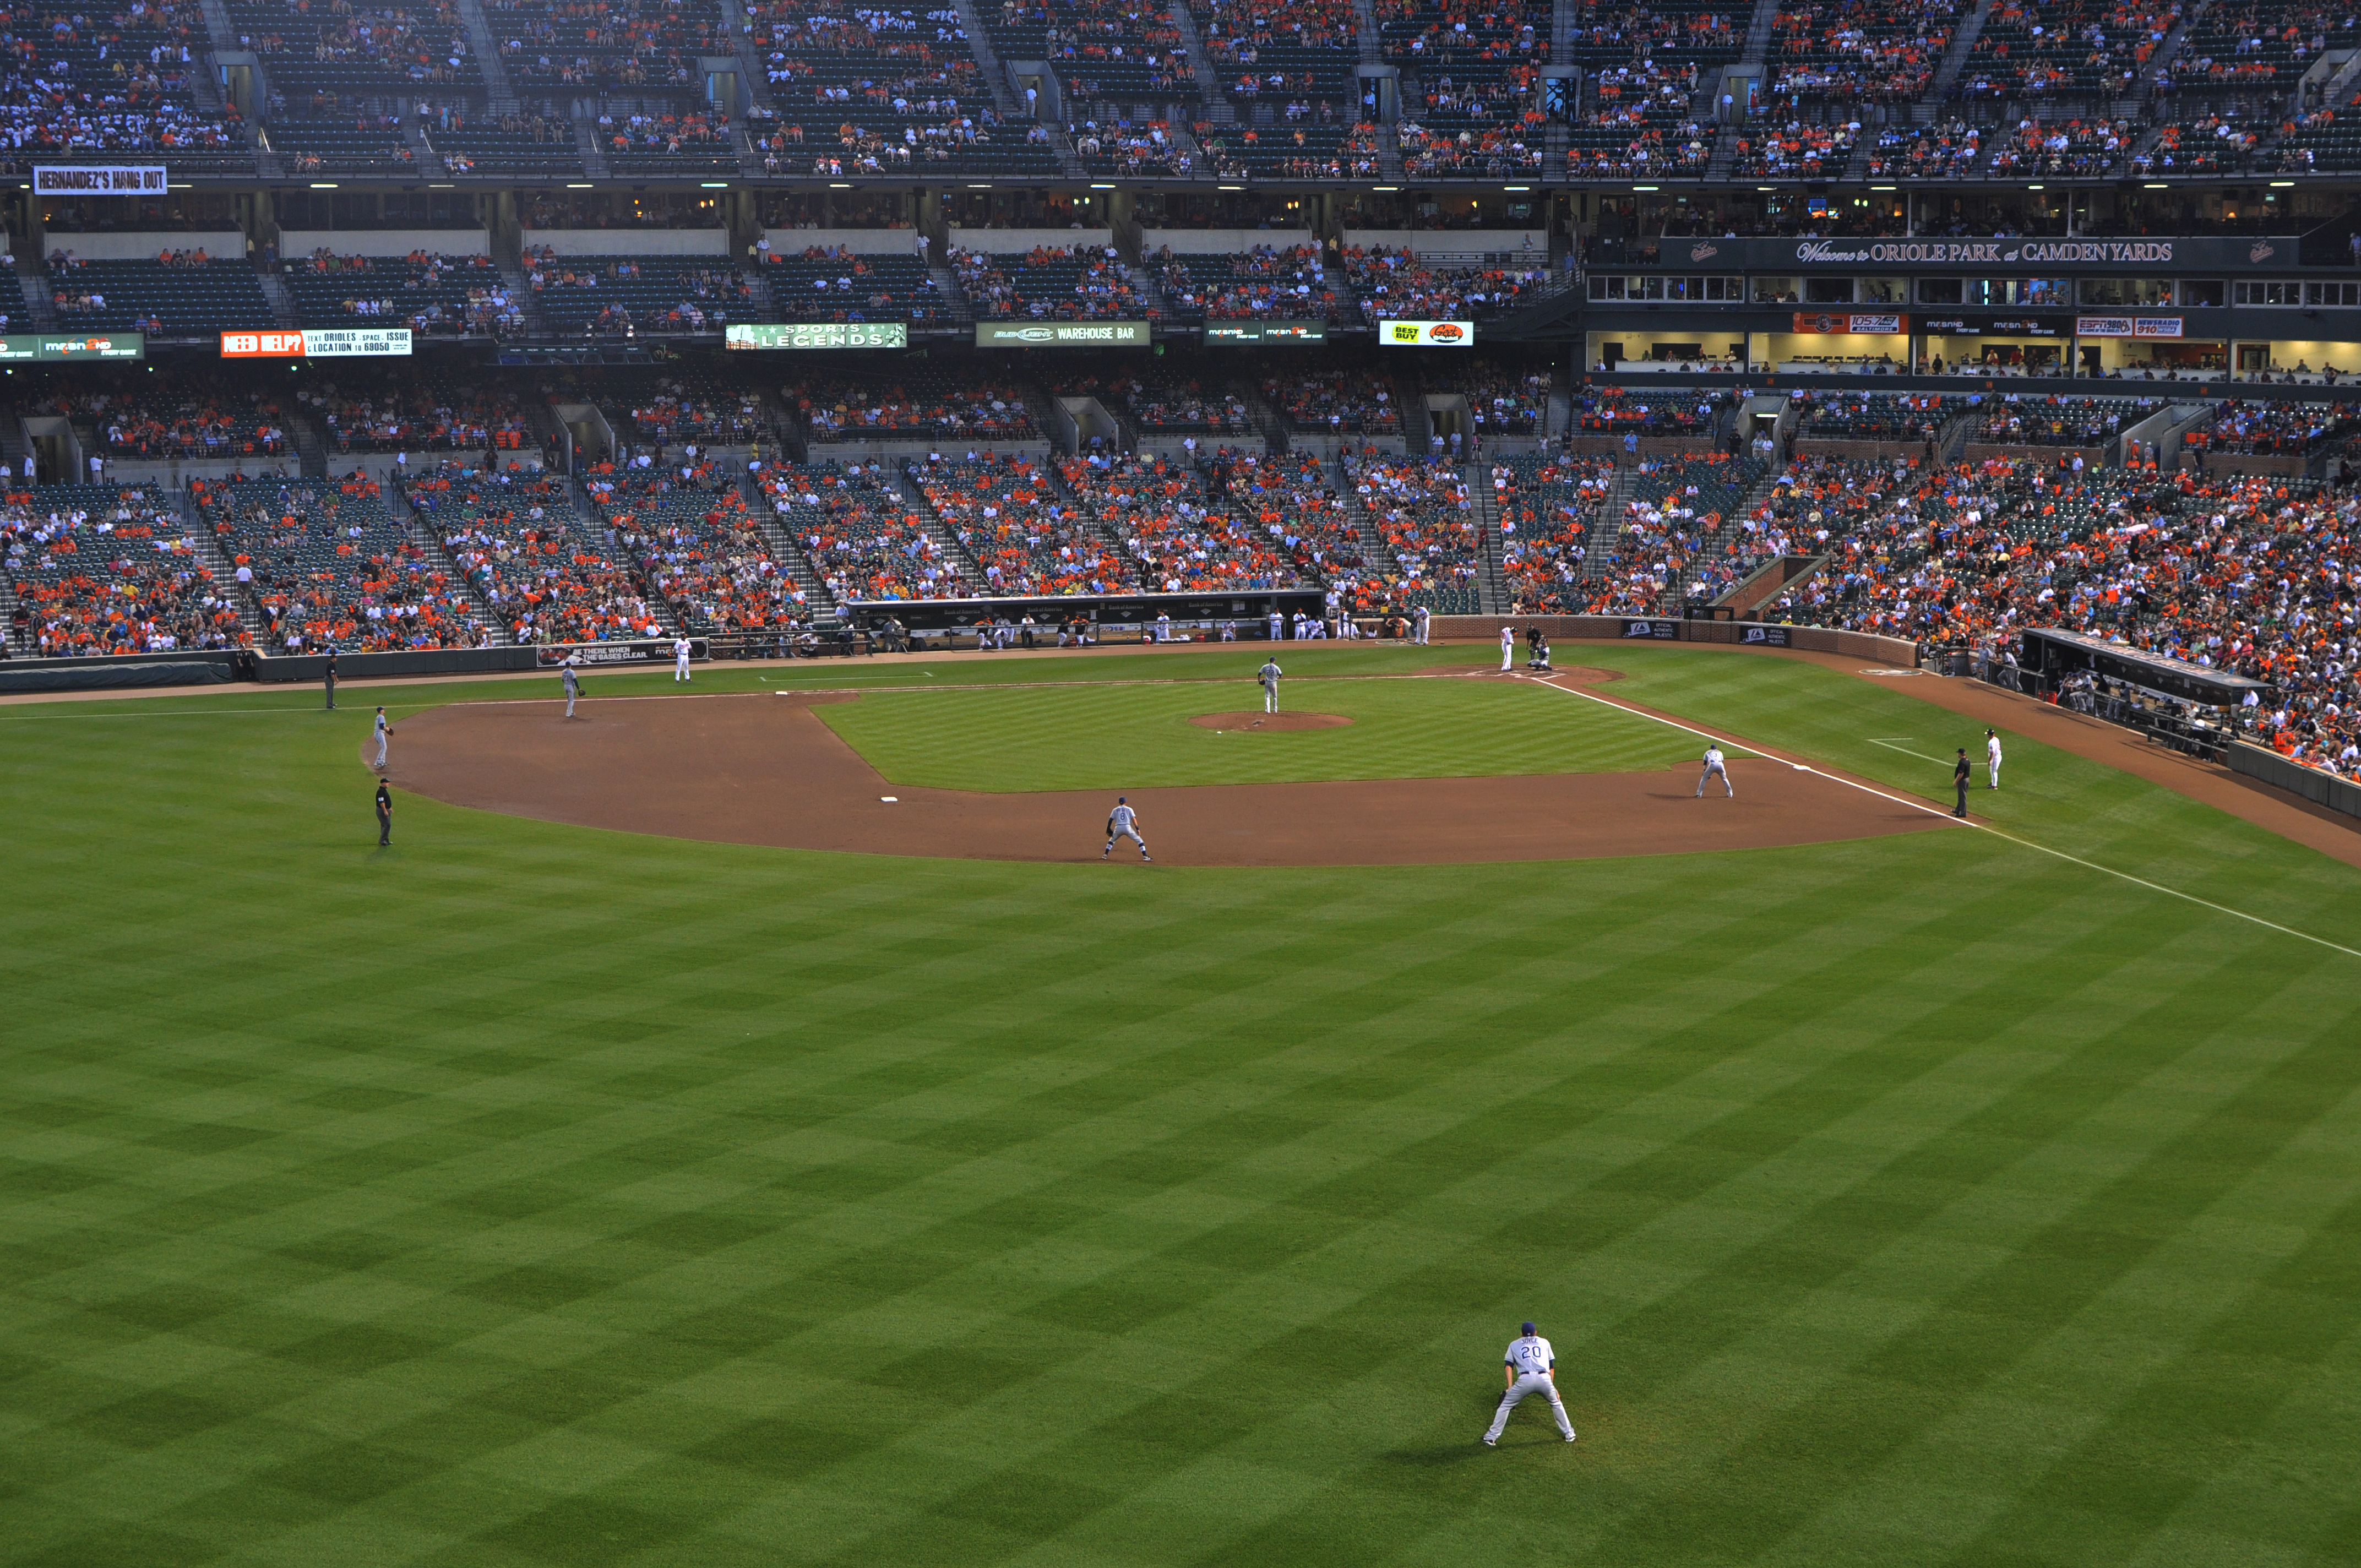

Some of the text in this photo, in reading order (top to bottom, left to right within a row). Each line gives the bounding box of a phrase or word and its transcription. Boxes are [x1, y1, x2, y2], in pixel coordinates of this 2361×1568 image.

[38, 171, 164, 189] HERNANDEZ'S HANG OUT
[1797, 240, 2172, 262] Welcome to ORIOLE PARK at CAMDEN YARDS
[1852, 316, 1882, 325] 105.7
[785, 324, 860, 334] SPORTS
[1057, 327, 1134, 340] WAREHOUSE BAR
[1434, 324, 1457, 337] Geek
[2137, 325, 2157, 334] 910
[224, 334, 302, 352] NEED HELP?
[324, 333, 356, 342] ORIOLES
[387, 331, 409, 341] ISSUE
[761, 334, 883, 347] LEGENDS
[313, 342, 352, 352] LOCATION
[364, 342, 389, 351] 69050
[1521, 1346, 1541, 1359] 20
